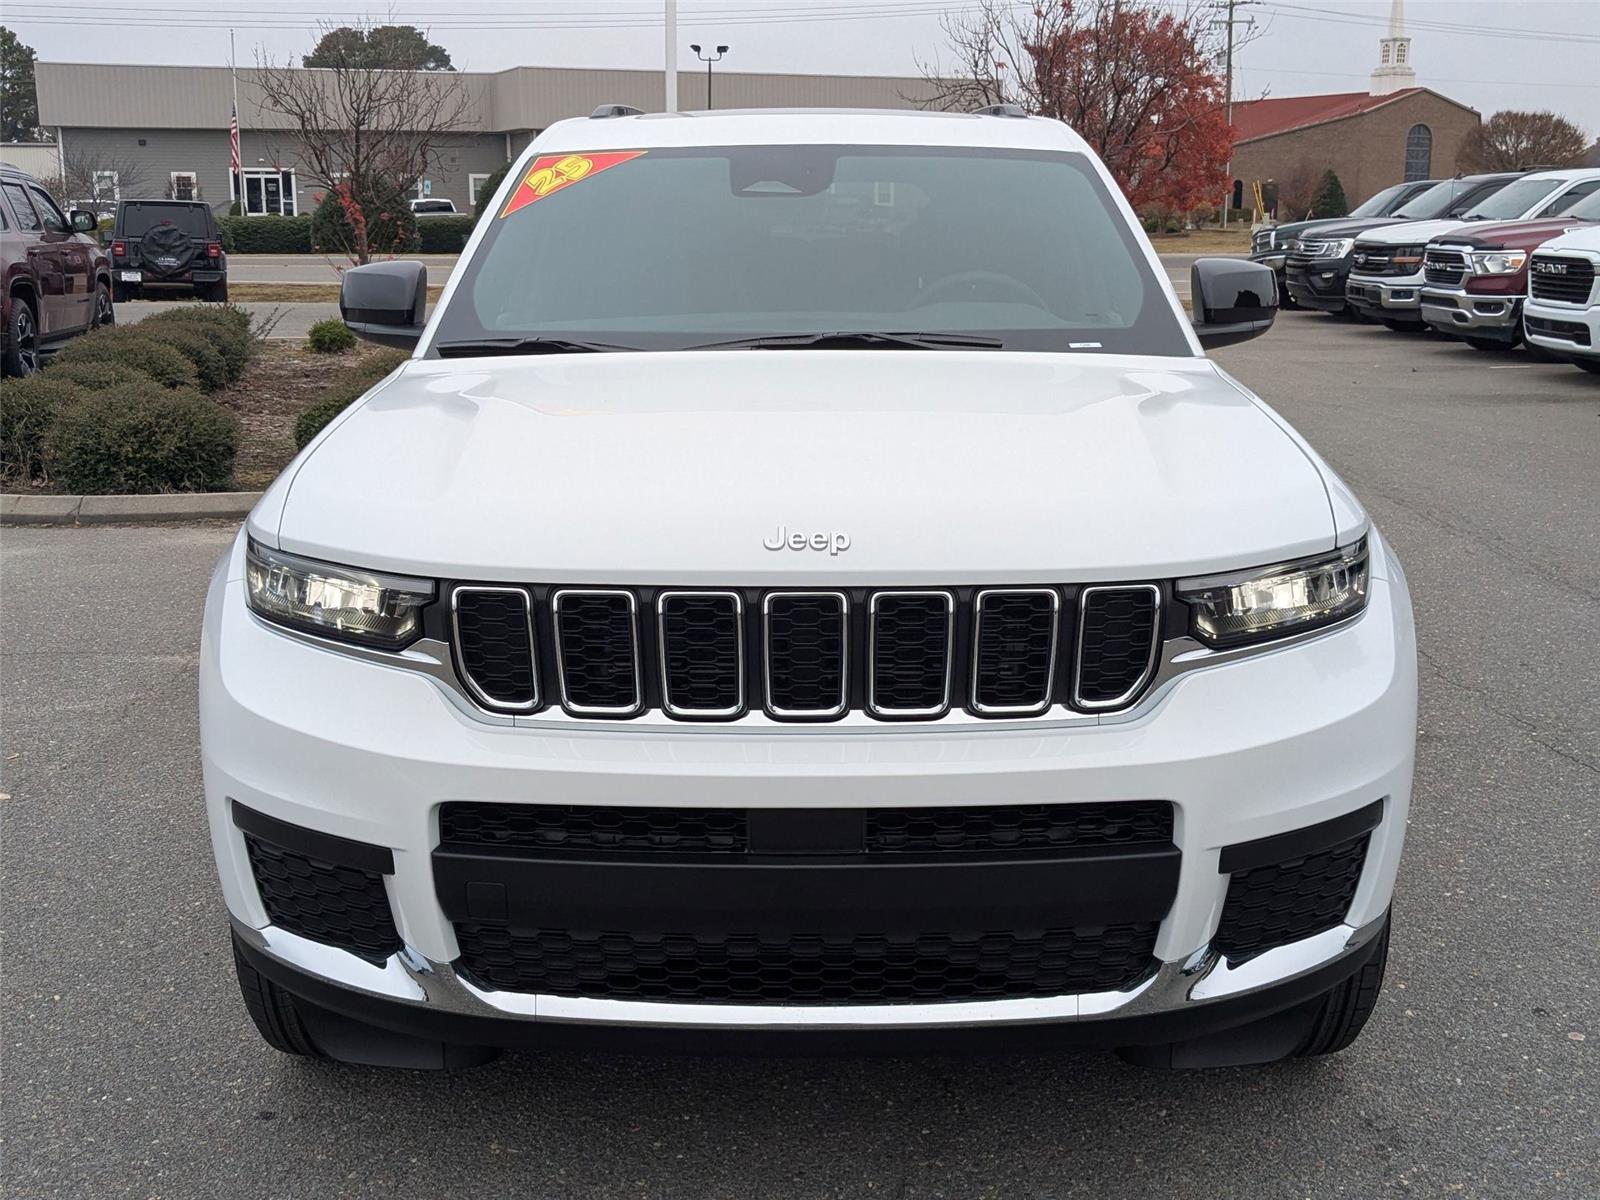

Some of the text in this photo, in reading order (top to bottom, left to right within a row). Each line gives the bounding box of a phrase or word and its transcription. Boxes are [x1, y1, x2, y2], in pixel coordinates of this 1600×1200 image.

[525, 155, 593, 195] 25
[1536, 263, 1567, 274] RAM
[763, 526, 851, 556] Jeep
